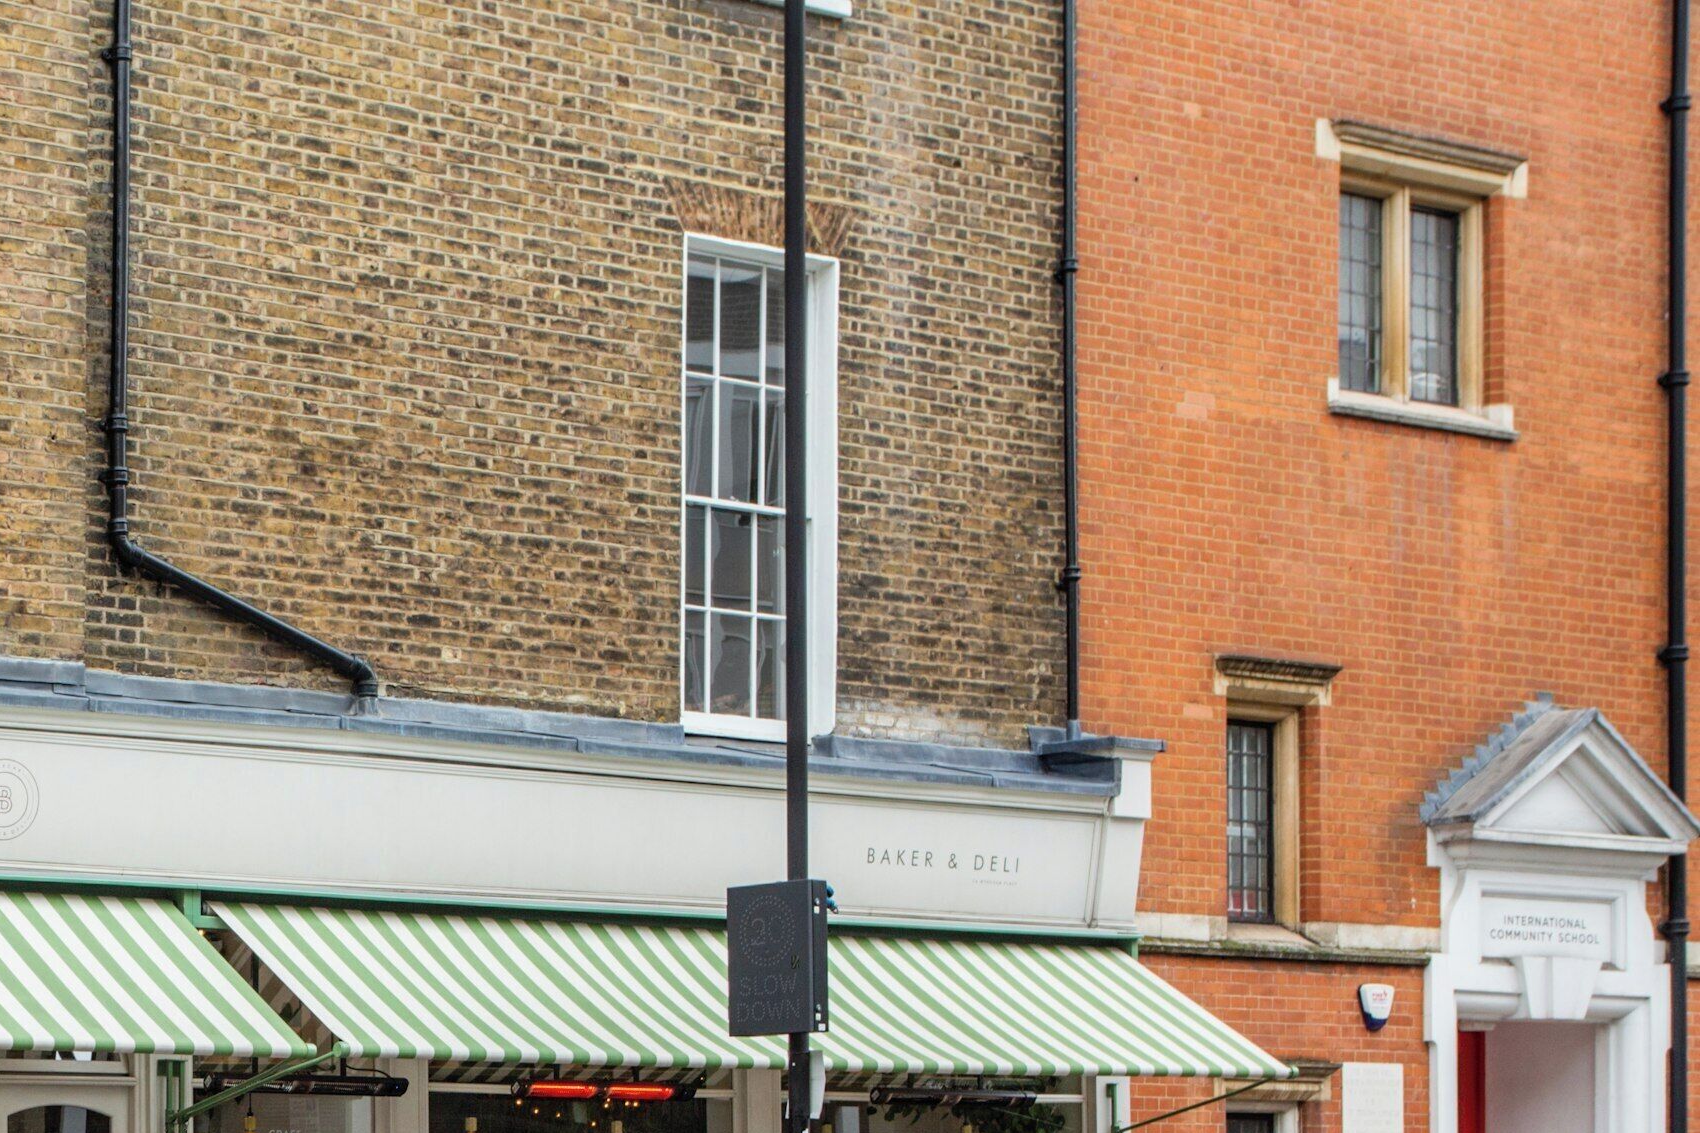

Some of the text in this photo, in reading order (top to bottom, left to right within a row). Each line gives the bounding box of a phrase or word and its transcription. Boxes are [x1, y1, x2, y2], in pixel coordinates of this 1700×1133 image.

[867, 848, 1019, 873] BAKER & DELI
[1503, 915, 1586, 930] INTERNATIONAL
[1490, 928, 1600, 945] COMMUNITY SCHOOL
[739, 972, 798, 997] SLOW
[736, 998, 801, 1023] DOWN
